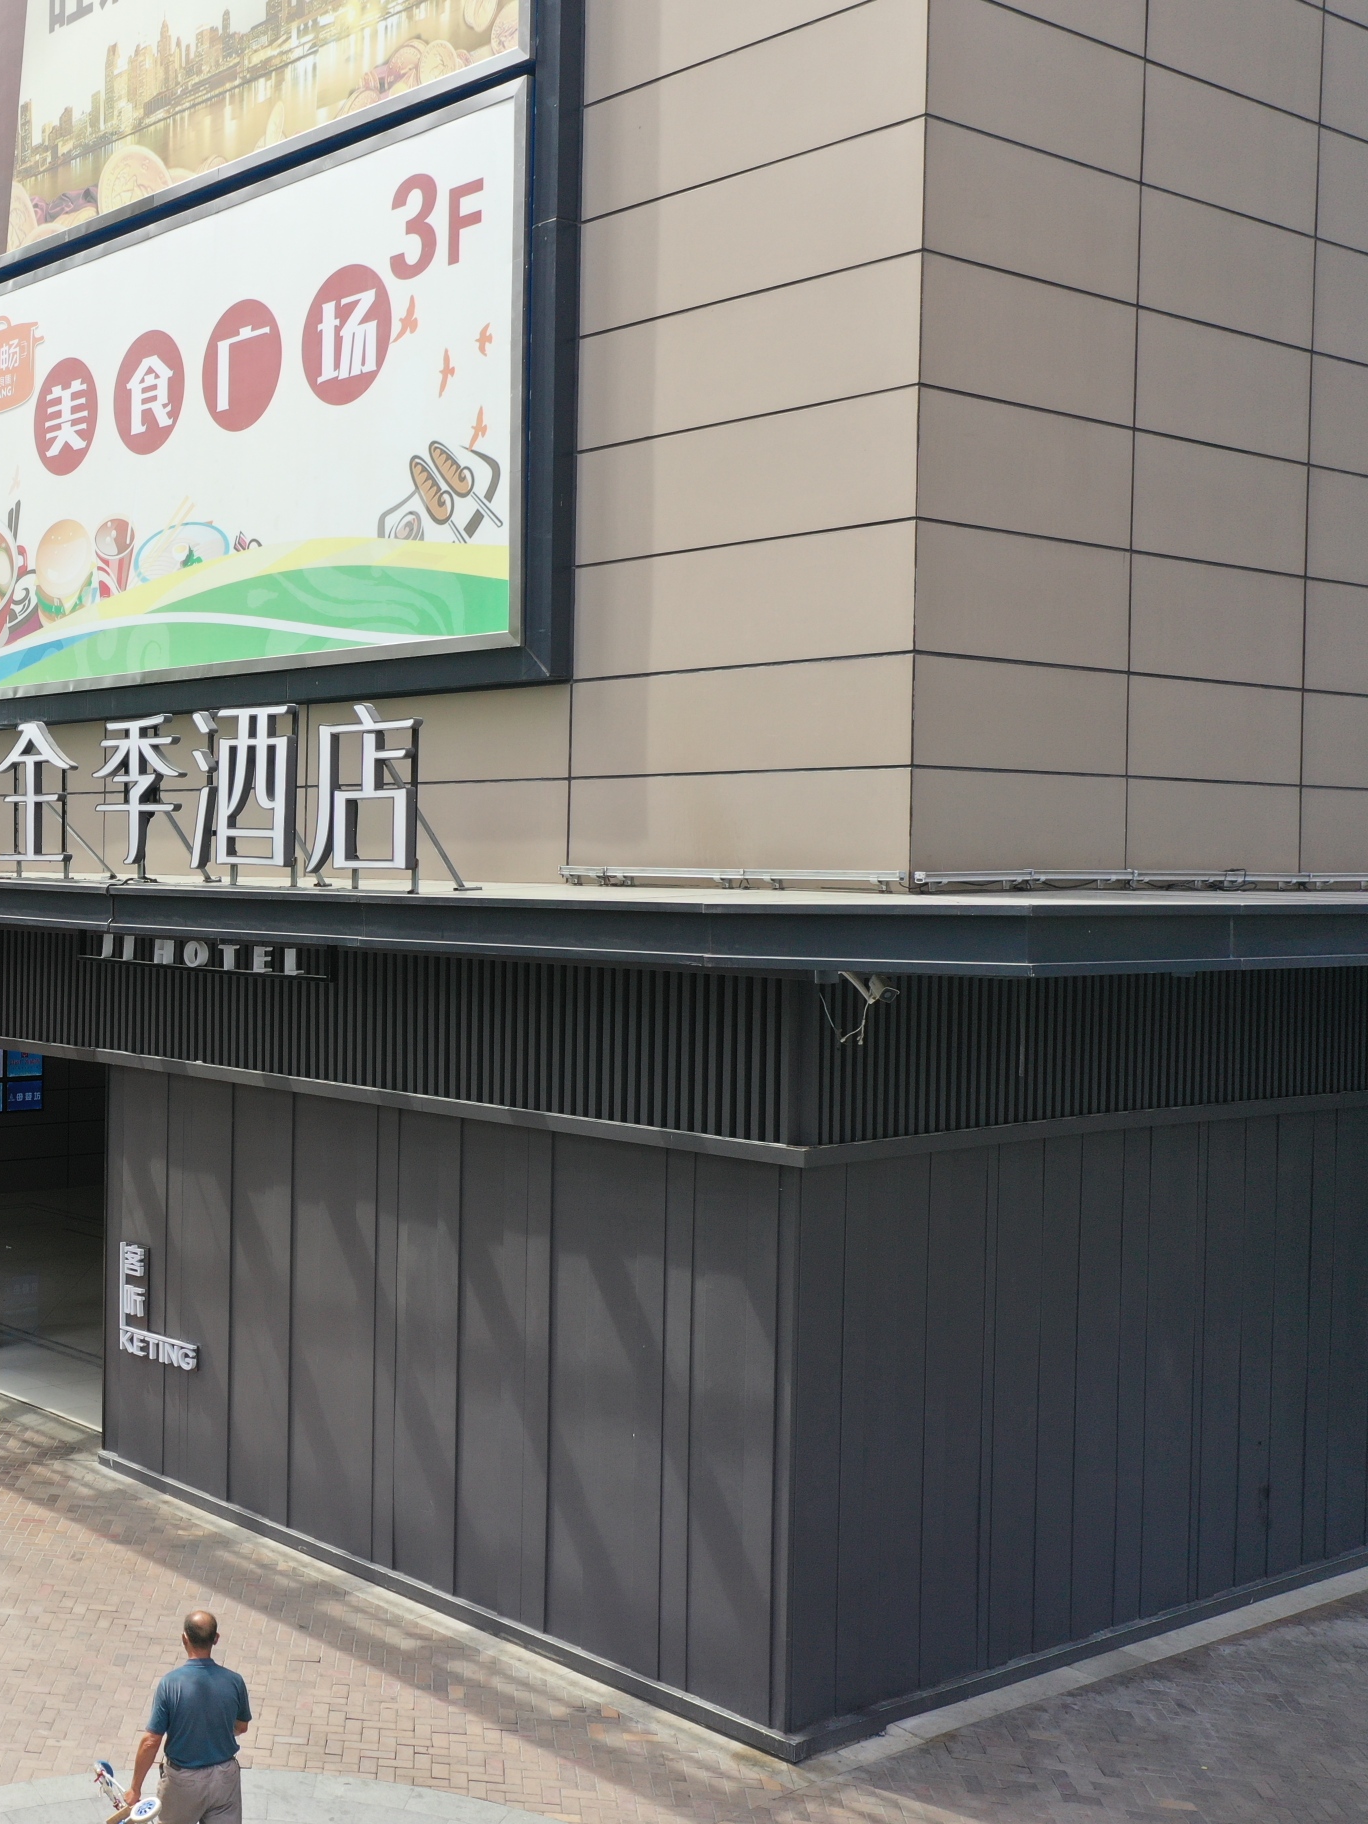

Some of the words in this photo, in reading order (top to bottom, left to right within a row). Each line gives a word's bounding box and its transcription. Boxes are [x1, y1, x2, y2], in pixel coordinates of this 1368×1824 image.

[389, 173, 484, 280] 3F
[45, 287, 378, 460] 美食广场
[101, 933, 135, 961] JI
[154, 939, 305, 976] HOTEL
[120, 1330, 197, 1370] KETING
